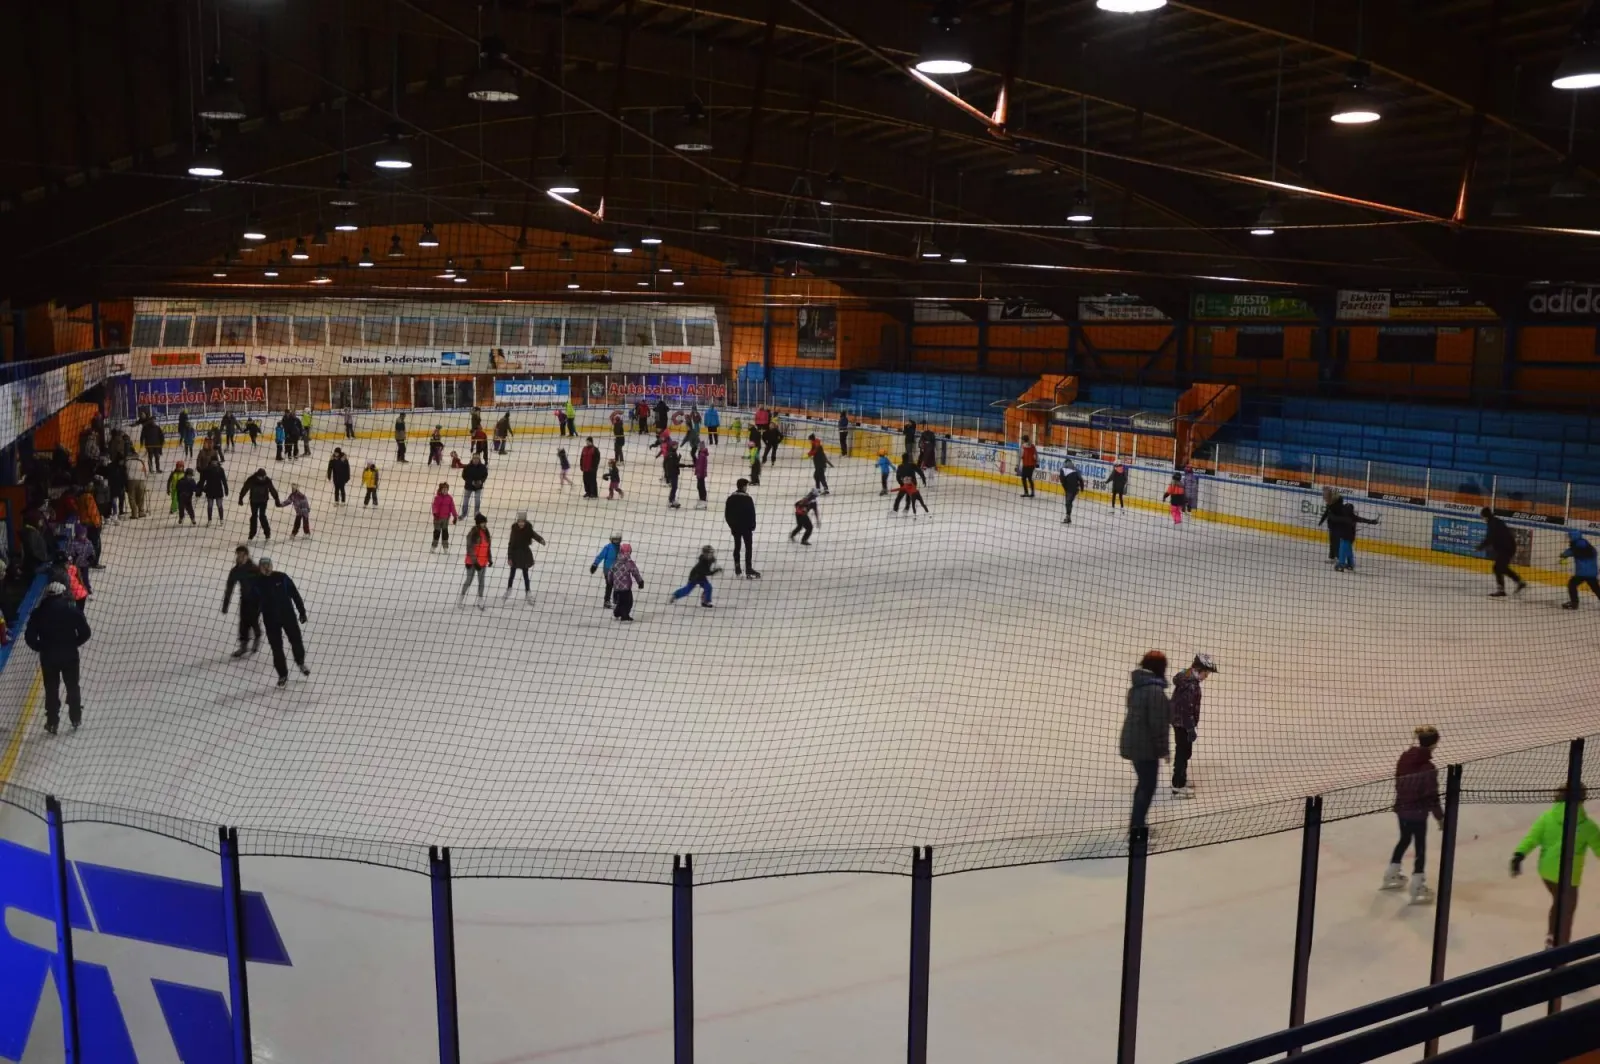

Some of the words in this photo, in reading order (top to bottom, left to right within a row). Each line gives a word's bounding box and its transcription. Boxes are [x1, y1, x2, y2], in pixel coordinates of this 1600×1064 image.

[1340, 301, 1384, 311] Partner
[343, 355, 380, 364] Marius
[384, 355, 437, 365] Pedersen
[505, 384, 557, 394] DECATHLON
[608, 383, 684, 397] Autosalon
[686, 384, 727, 398] ASTRA
[138, 389, 207, 405] Autosalon
[209, 386, 266, 403] ASTRA
